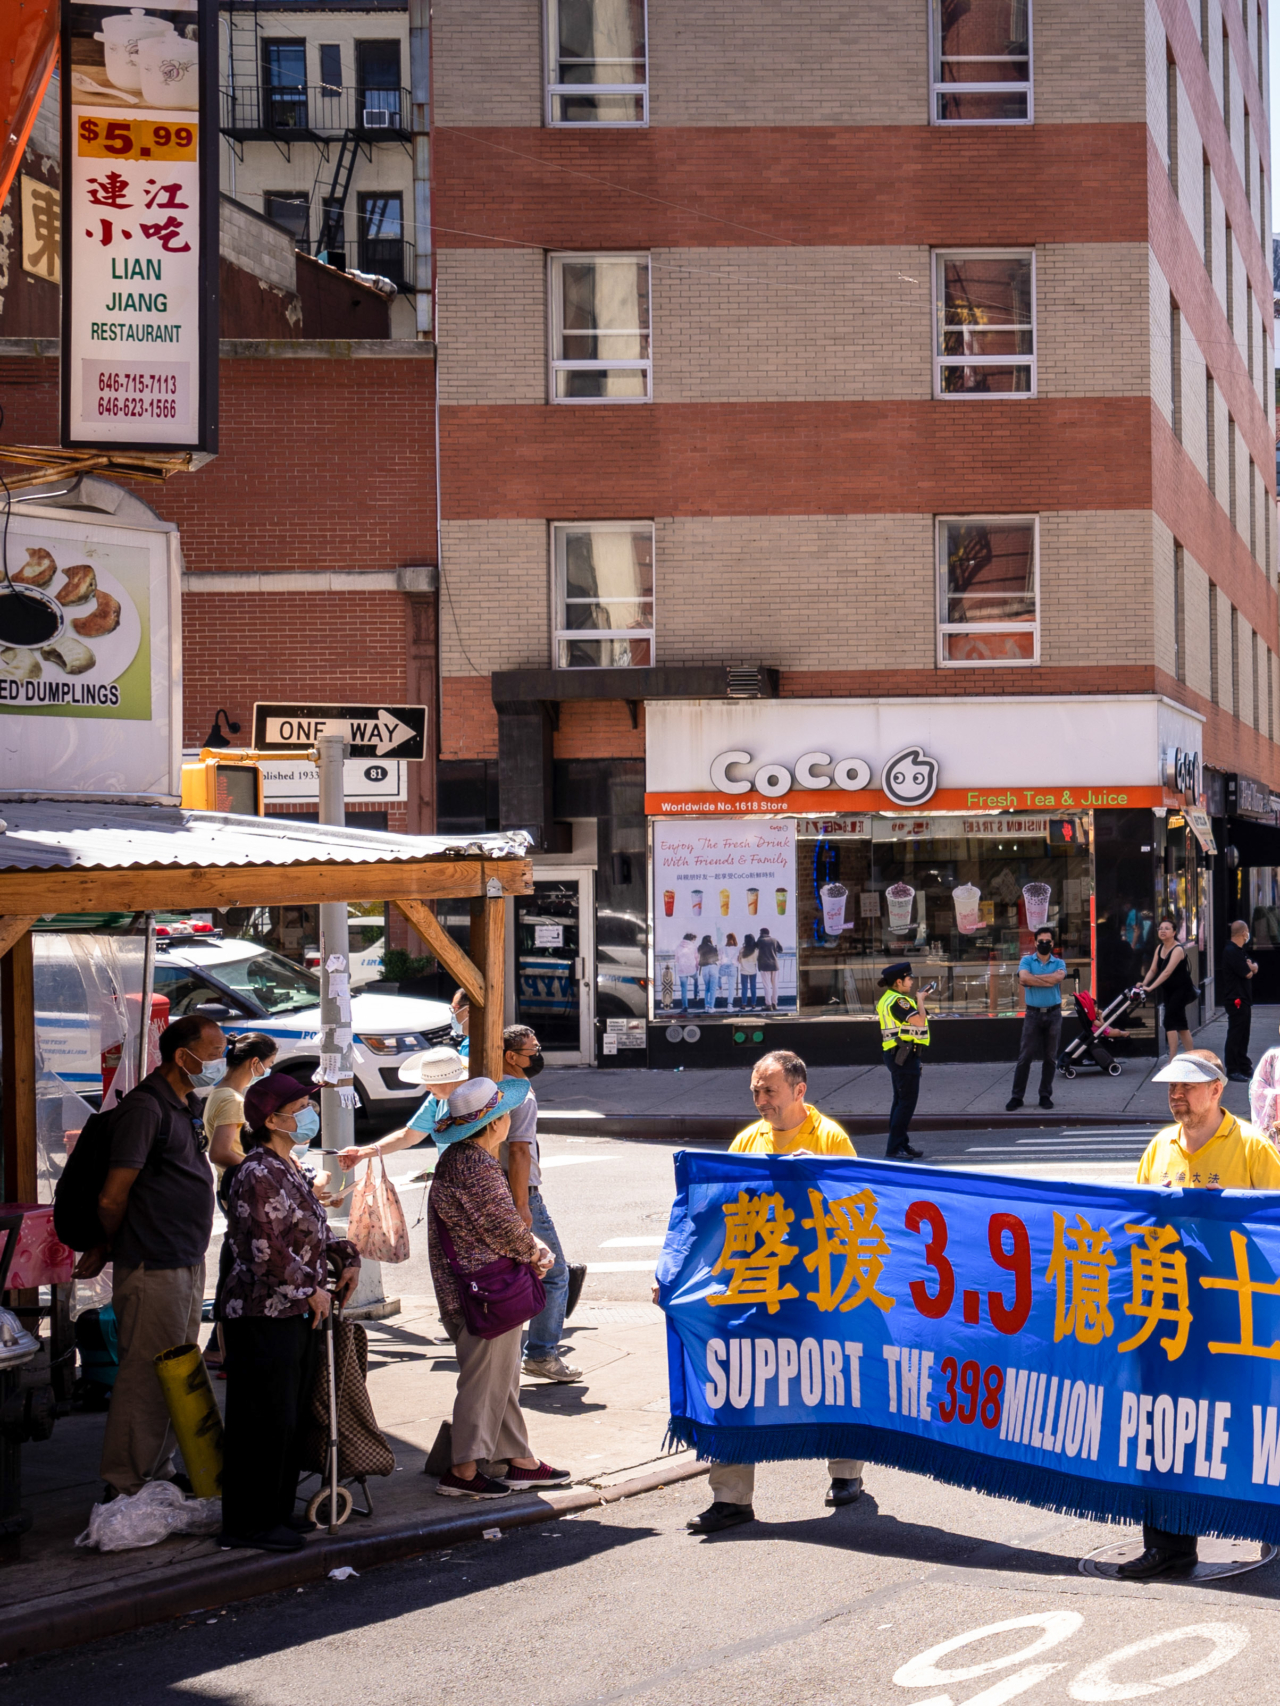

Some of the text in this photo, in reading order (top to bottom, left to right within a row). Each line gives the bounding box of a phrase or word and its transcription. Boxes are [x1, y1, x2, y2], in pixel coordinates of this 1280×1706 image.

[79, 118, 194, 157] $5.99
[86, 171, 190, 210] 連江
[85, 215, 192, 253] 小吃
[111, 257, 162, 281] LIAN
[105, 293, 168, 313] JIANG
[90, 322, 182, 344] RESTAURANT
[98, 372, 178, 395] 646-715-7113
[97, 396, 177, 419] 646-623-1566
[25, 680, 119, 705] DUMPLINGS
[279, 721, 400, 742] ONE WAY
[298, 772, 320, 780] 1933
[370, 768, 382, 779] 81
[661, 802, 788, 812] Worldwide No.1618 Store
[967, 790, 1128, 807] Fresh Tea & Juice
[661, 835, 790, 854] Enjoy The Fresh Drink
[663, 852, 788, 868] With Friends & Family
[705, 1337, 864, 1410] SUPPORT
[882, 1344, 935, 1421] THE
[937, 1356, 1005, 1430] 398
[1000, 1368, 1105, 1462] MILLION
[1118, 1390, 1232, 1481] PEOPLE
